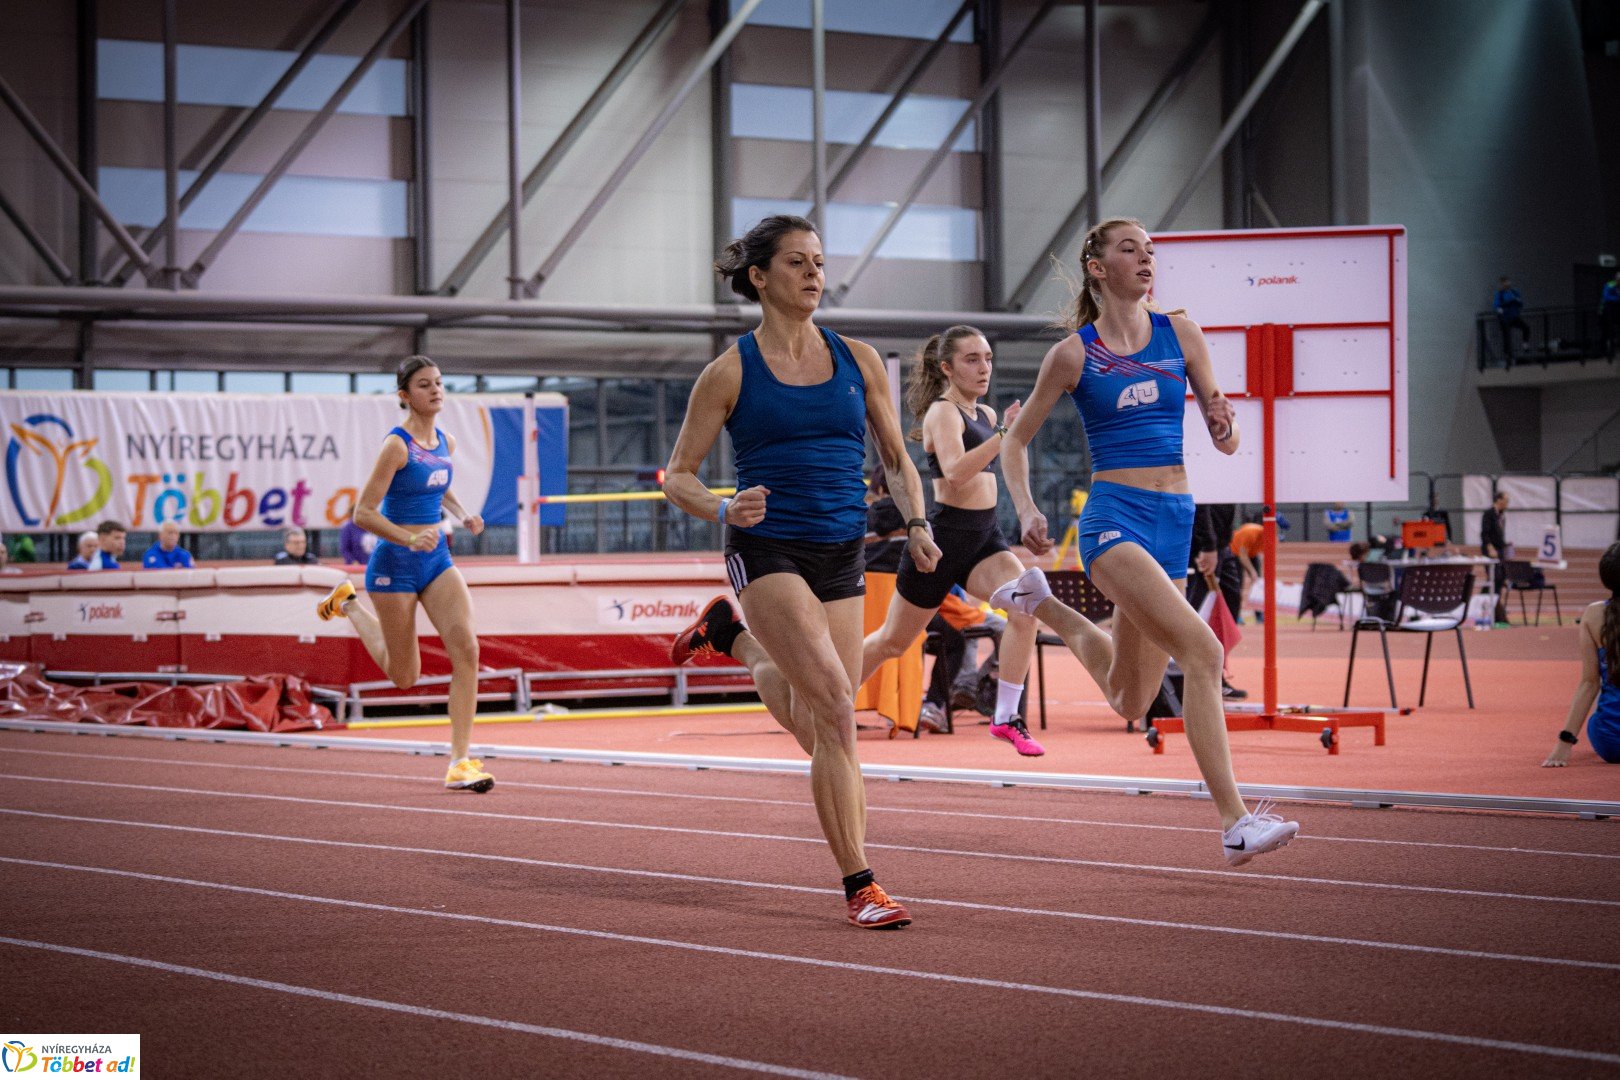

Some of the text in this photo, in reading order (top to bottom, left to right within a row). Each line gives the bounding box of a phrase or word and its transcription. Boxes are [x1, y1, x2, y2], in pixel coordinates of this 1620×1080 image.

[1258, 275, 1297, 287] polanik
[127, 428, 339, 460] NYÍREGYHÁZA
[128, 472, 312, 527] Többet
[1543, 533, 1556, 558] 5
[89, 603, 122, 621] polanik
[631, 600, 699, 621] polanik
